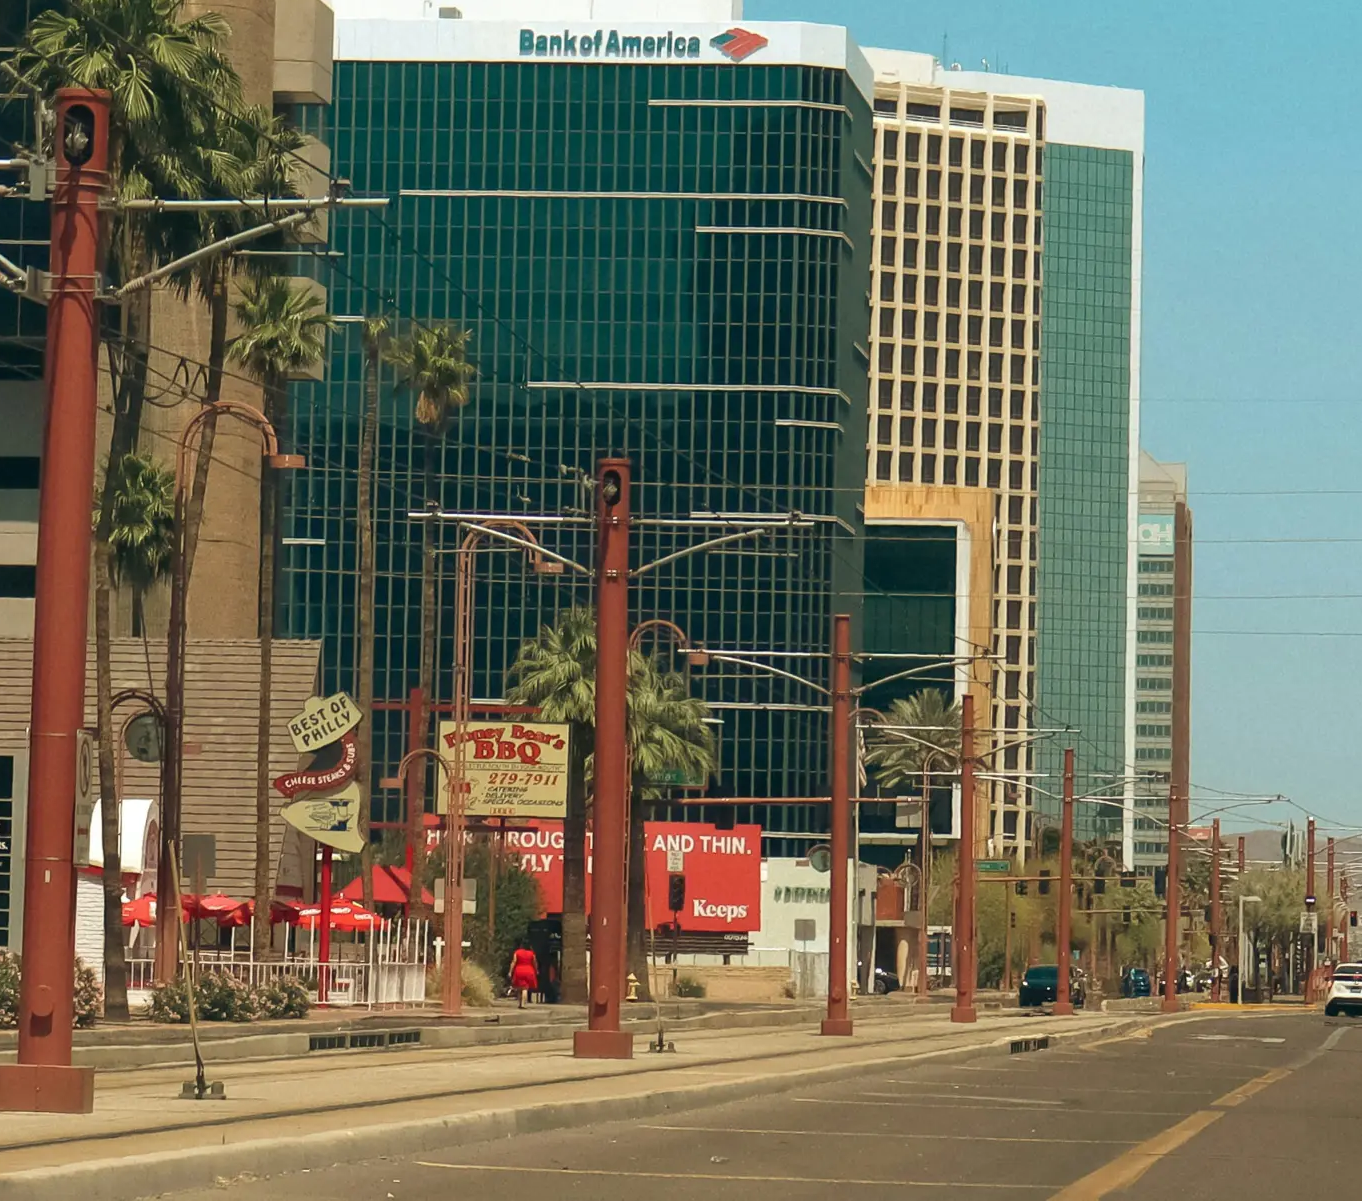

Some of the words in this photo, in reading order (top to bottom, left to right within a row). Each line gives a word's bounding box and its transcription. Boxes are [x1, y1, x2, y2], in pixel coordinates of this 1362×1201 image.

[519, 28, 577, 57] Bank
[580, 29, 603, 57] of
[605, 29, 701, 58] America
[290, 708, 327, 737] BEST
[330, 696, 348, 715] OF
[302, 710, 351, 747] PHILLY
[511, 724, 566, 750] Bear's
[473, 740, 542, 765] BBQ
[285, 774, 316, 789] CHEESE
[318, 767, 346, 785] STEAKS
[346, 743, 356, 763] SUBS
[487, 772, 558, 786] 279-7911
[653, 834, 694, 853] AND
[700, 835, 752, 855] THIN.
[692, 899, 749, 924] Keeps
